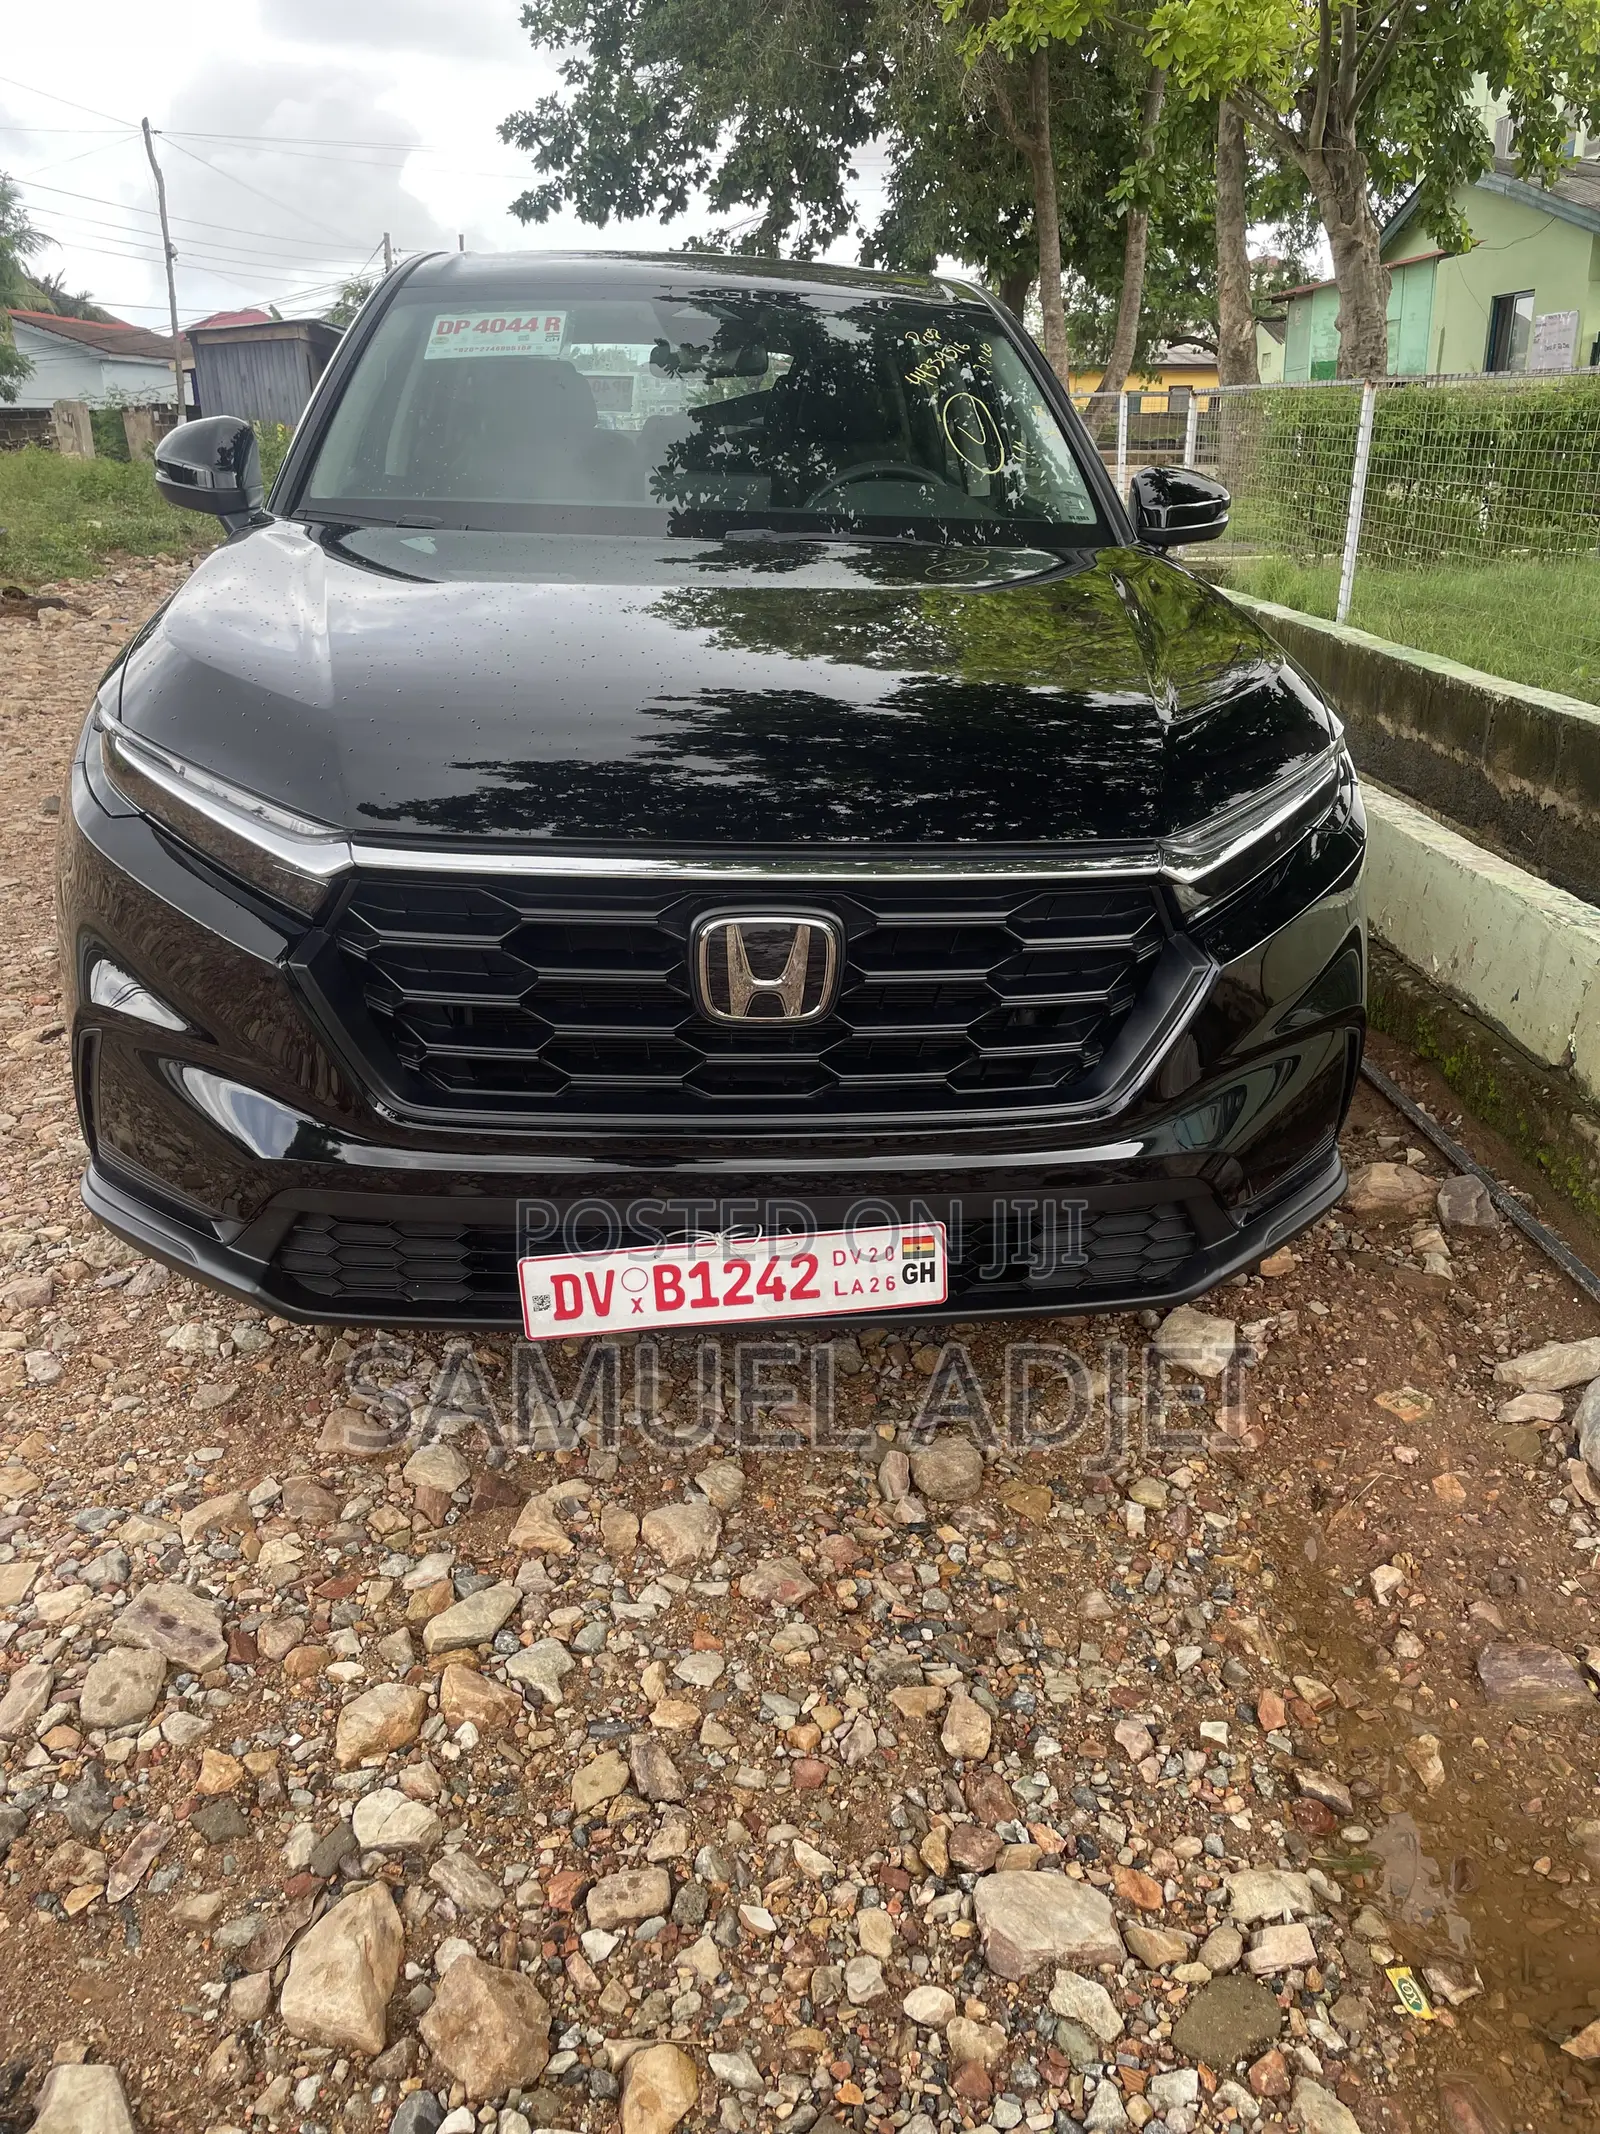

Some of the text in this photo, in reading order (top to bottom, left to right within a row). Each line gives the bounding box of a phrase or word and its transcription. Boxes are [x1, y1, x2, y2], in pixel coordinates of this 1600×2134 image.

[436, 316, 561, 336] DP 4044 R
[901, 1261, 936, 1285] GH
[549, 1269, 616, 1321] DV
[653, 1252, 821, 1312] B1242
[833, 1275, 897, 1296] LA26
